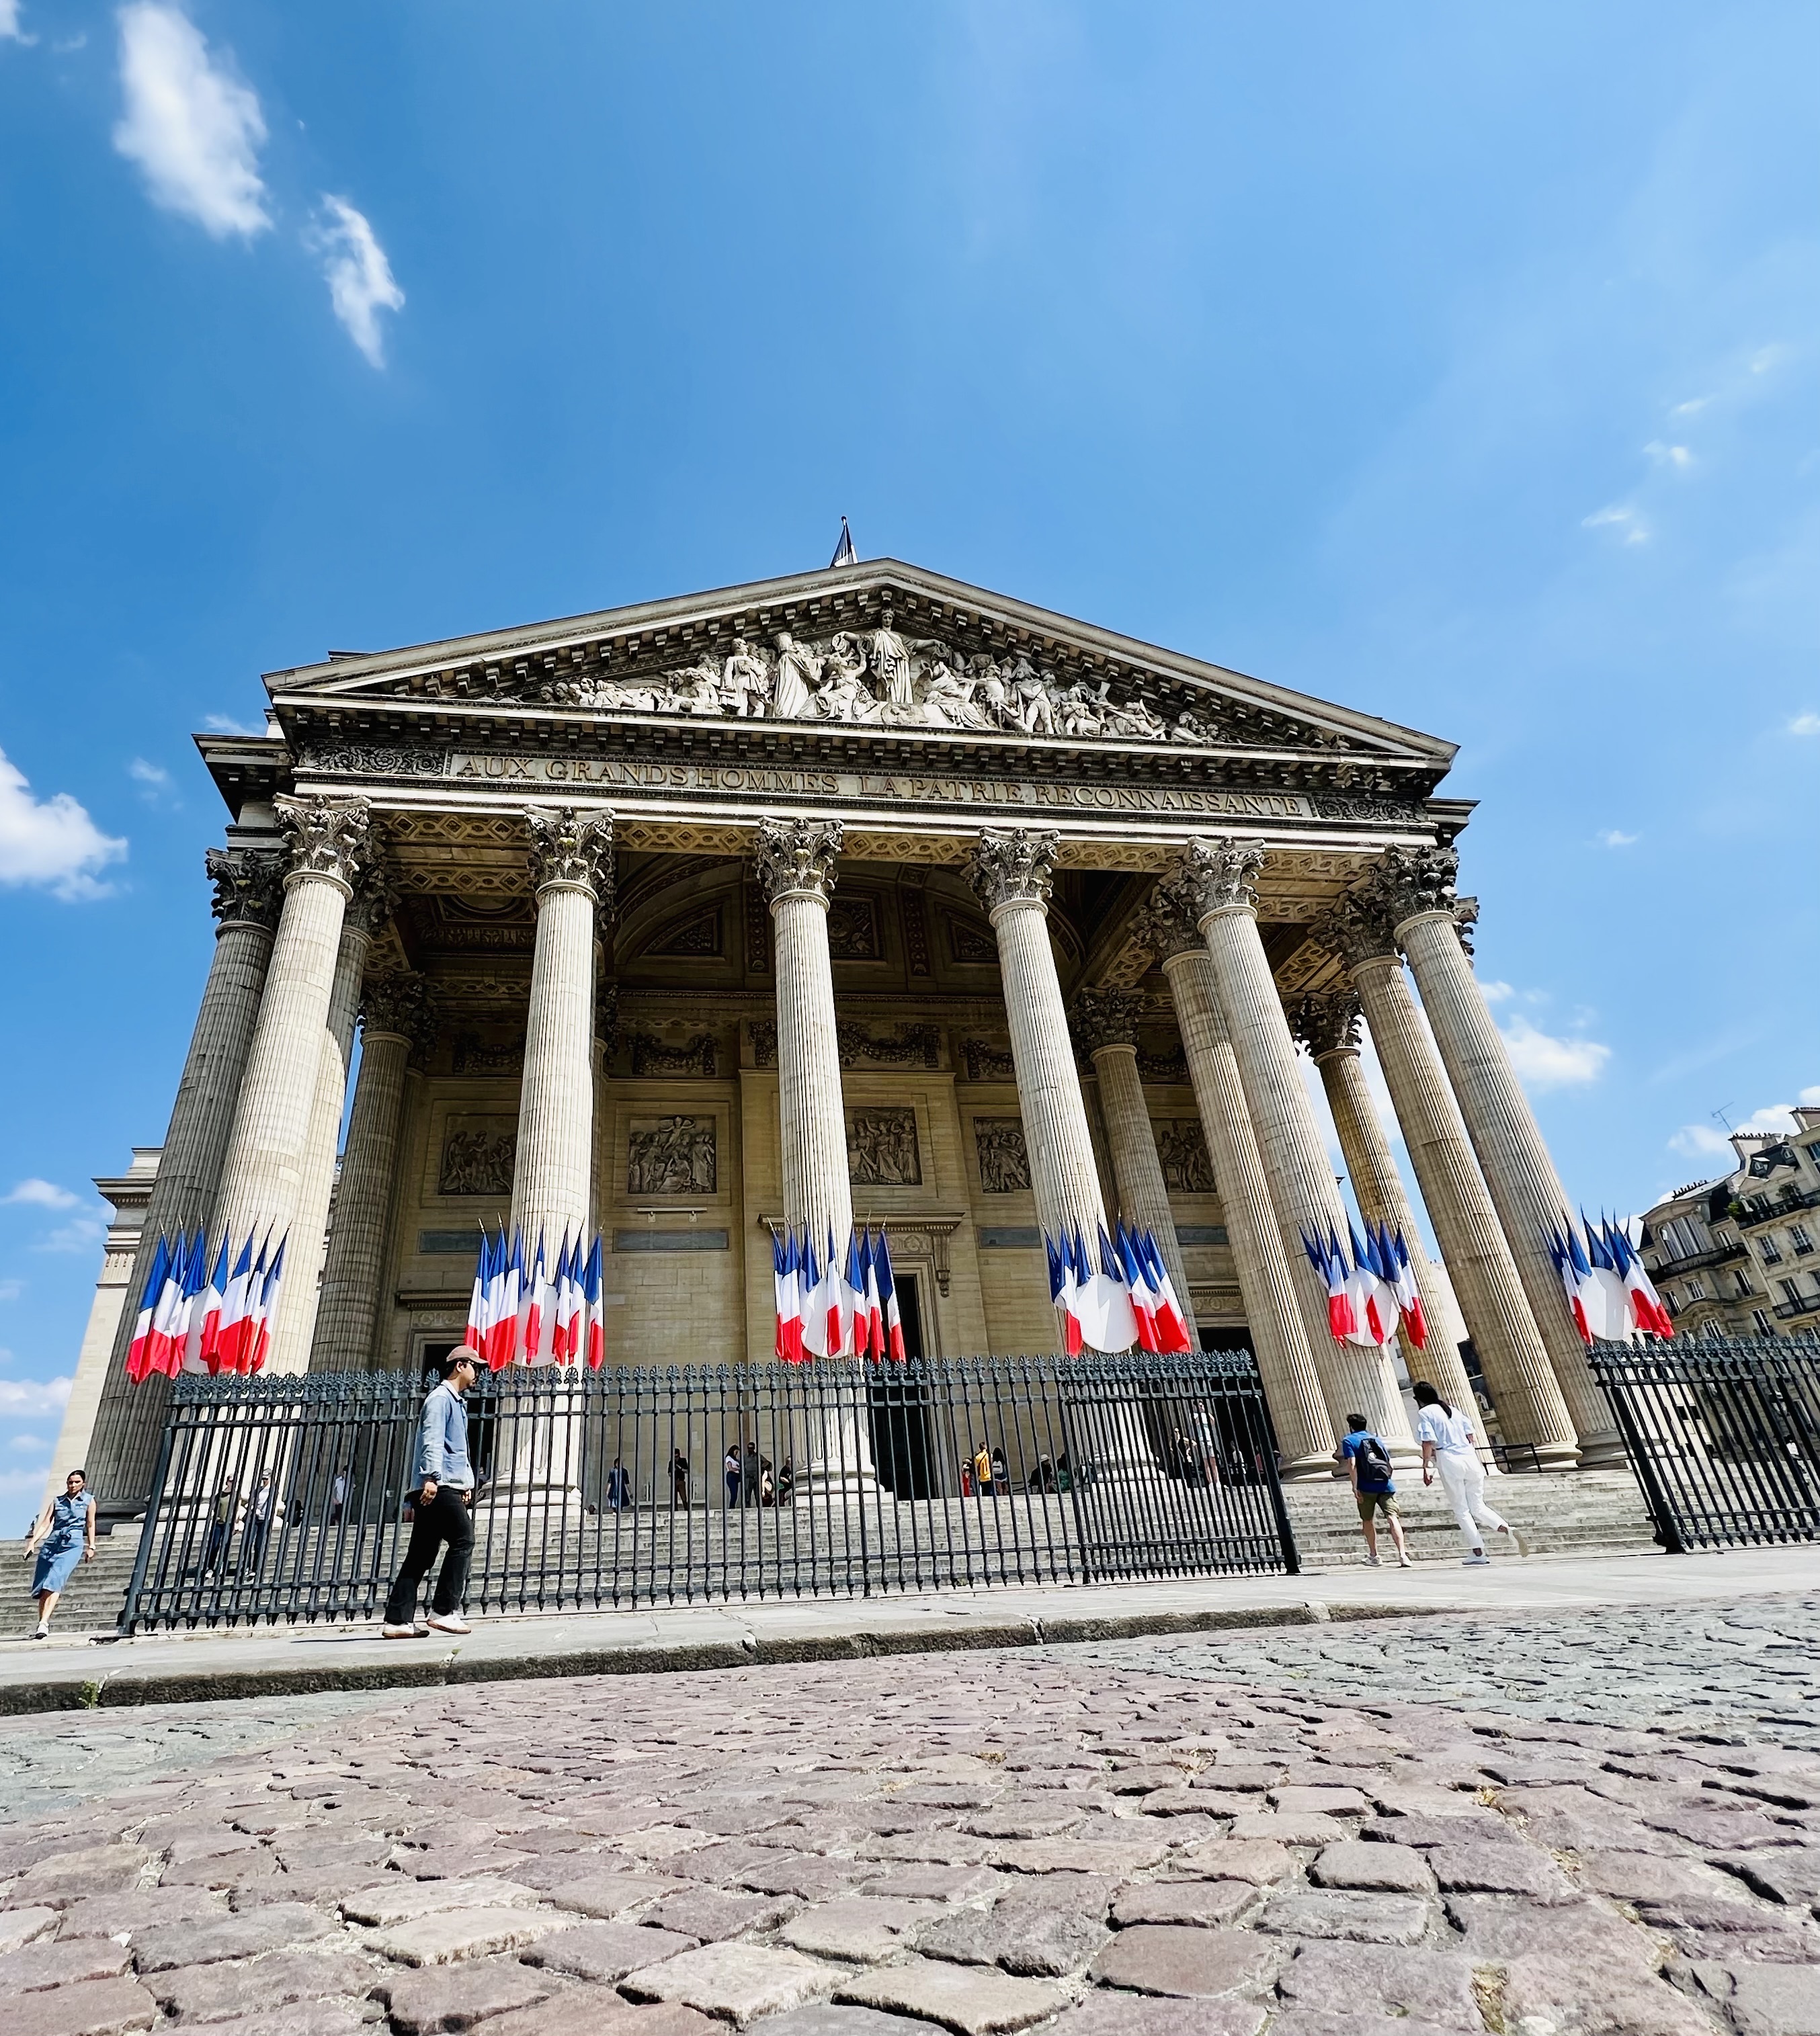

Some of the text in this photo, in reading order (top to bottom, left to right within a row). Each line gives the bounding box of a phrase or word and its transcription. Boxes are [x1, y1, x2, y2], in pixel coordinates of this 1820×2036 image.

[456, 757, 1303, 816] AUX GRANDS HOMMES LA PATRIE RECONNAISSANTE
